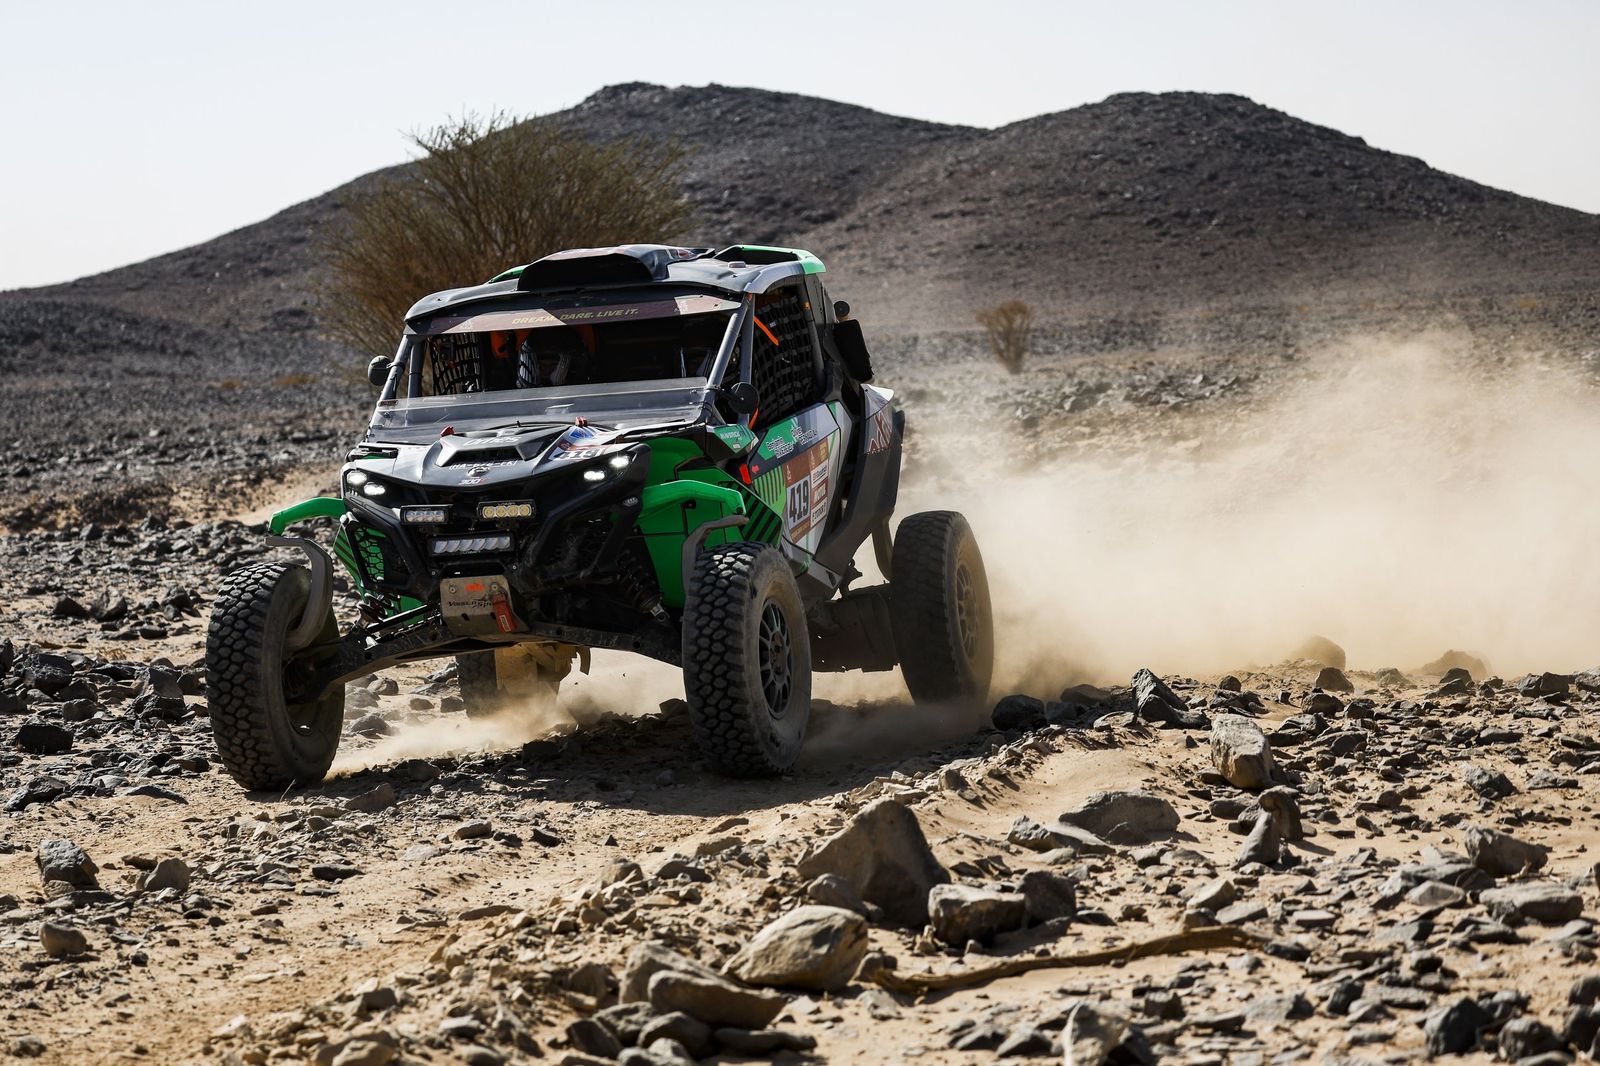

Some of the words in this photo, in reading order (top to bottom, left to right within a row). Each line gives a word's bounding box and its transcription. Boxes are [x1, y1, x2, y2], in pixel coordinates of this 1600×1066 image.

[560, 312, 595, 320] DARE.
[597, 309, 623, 317] LIVE
[789, 480, 810, 523] 419
